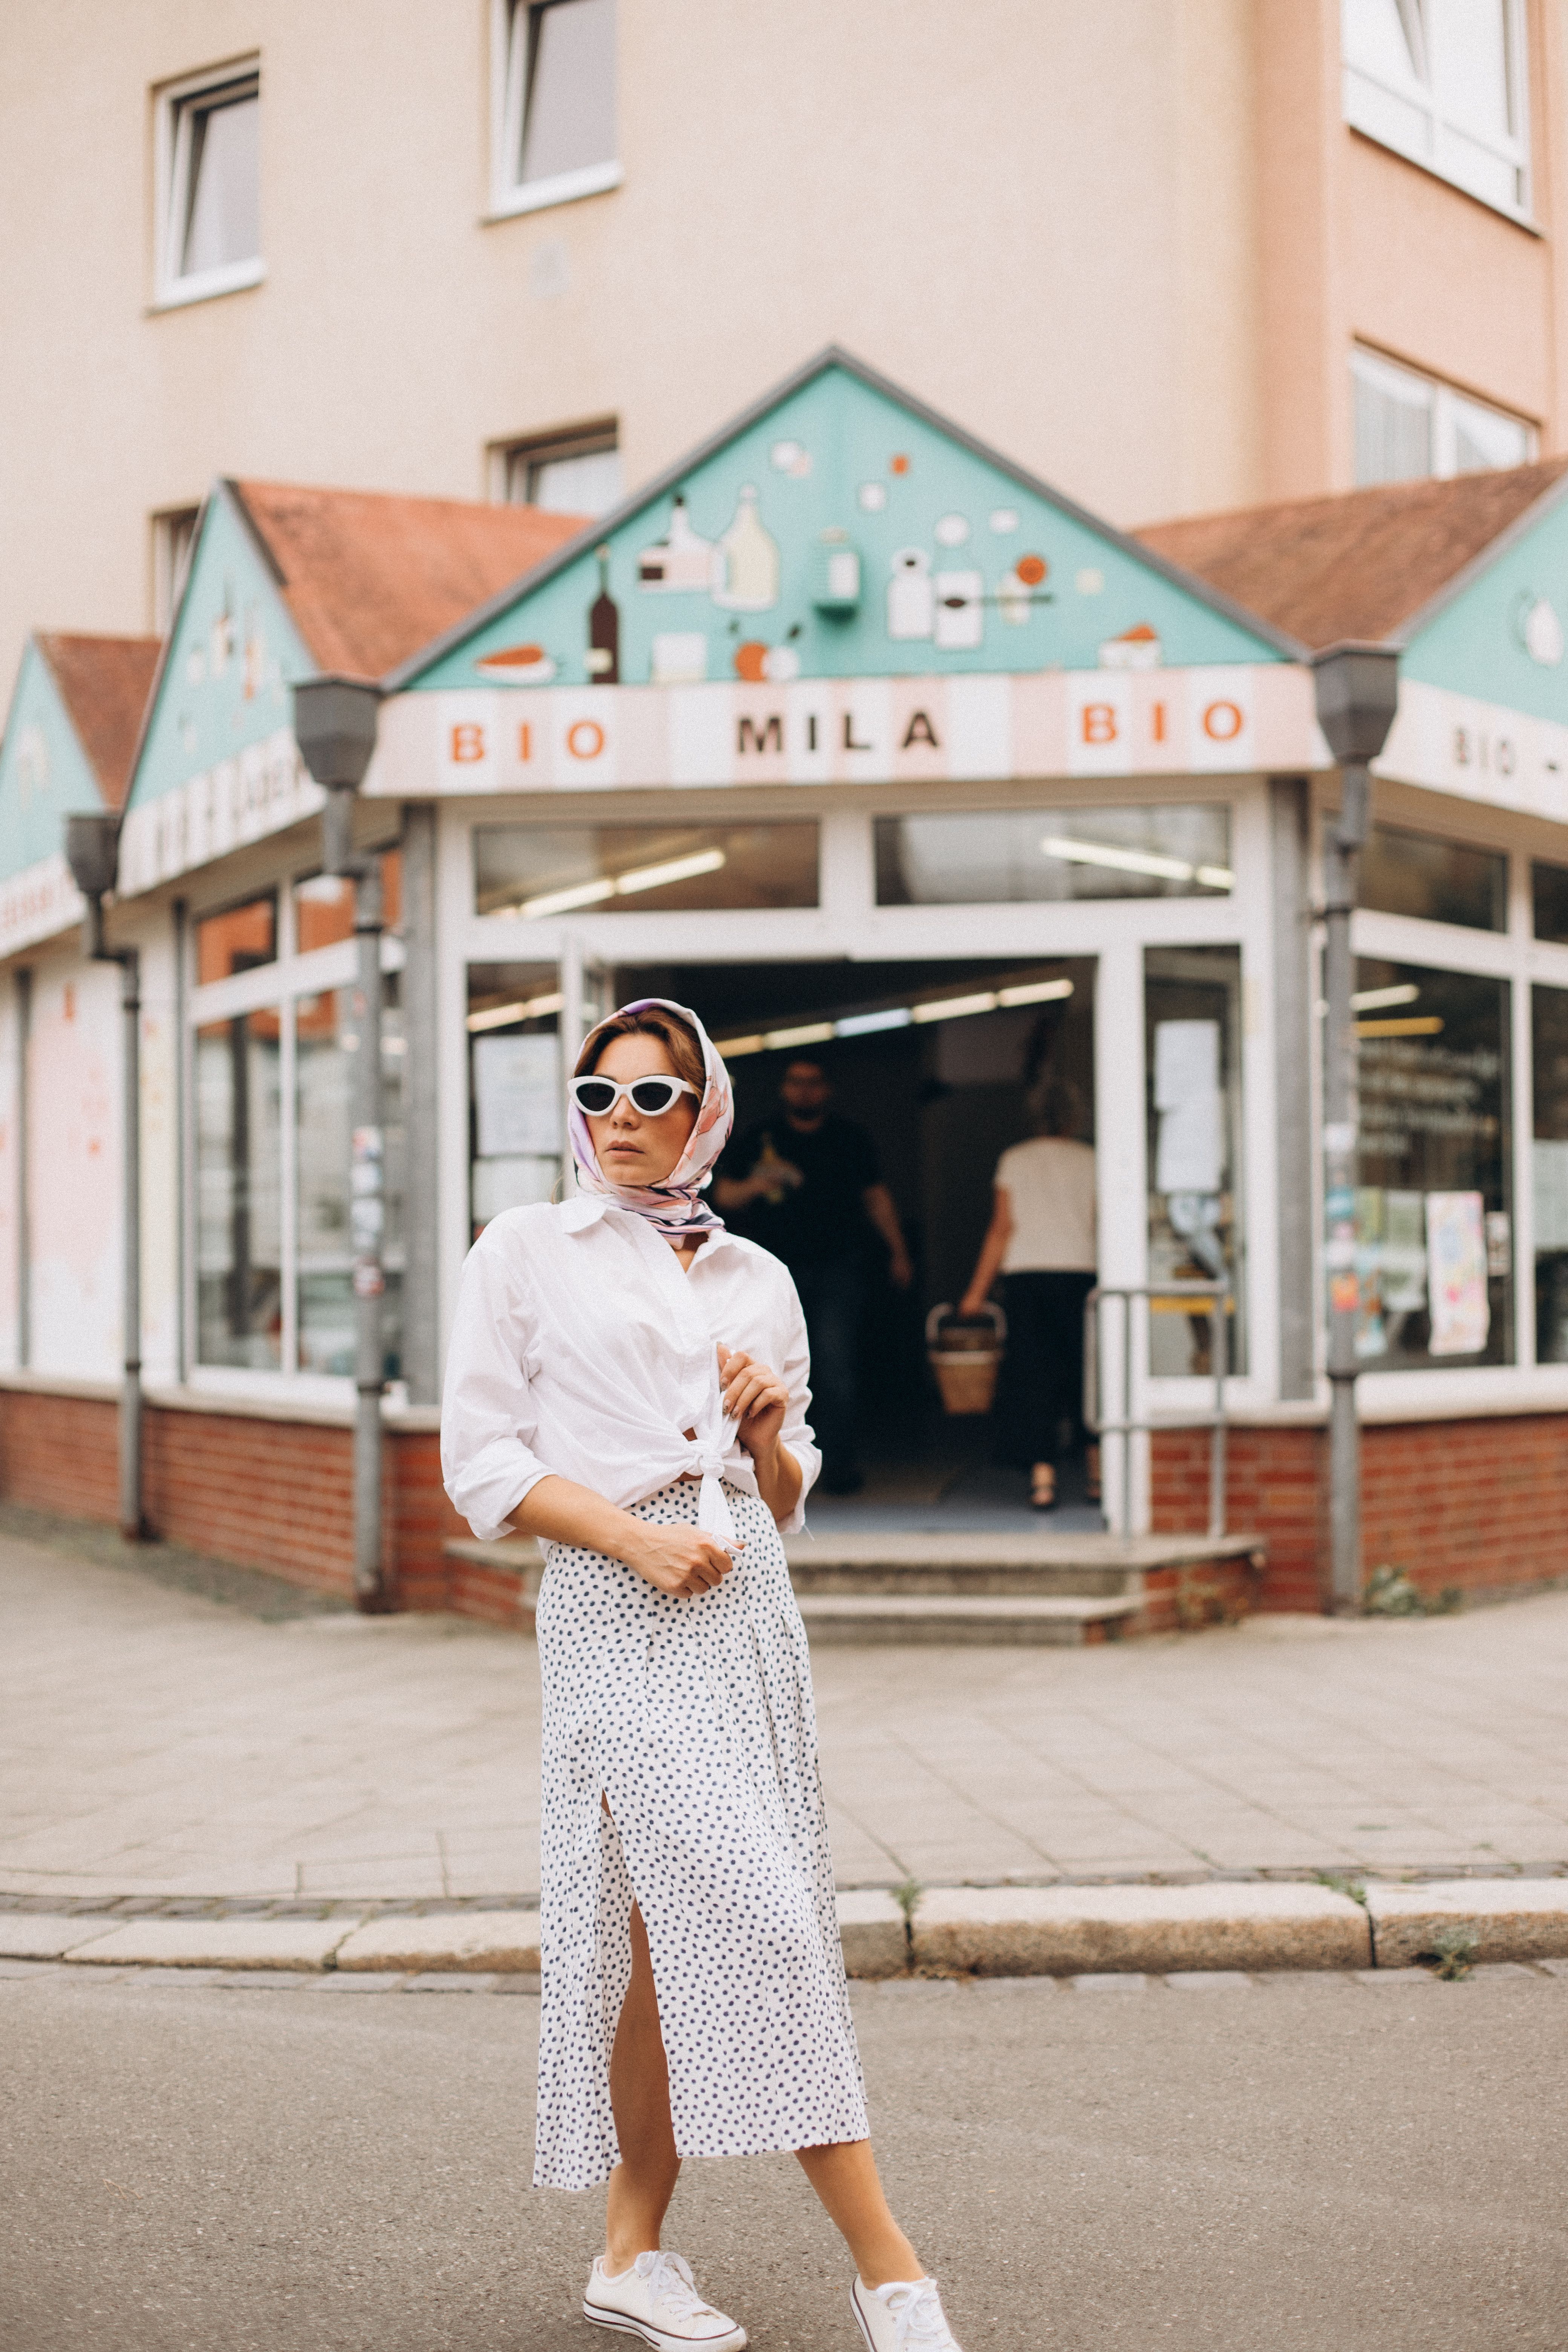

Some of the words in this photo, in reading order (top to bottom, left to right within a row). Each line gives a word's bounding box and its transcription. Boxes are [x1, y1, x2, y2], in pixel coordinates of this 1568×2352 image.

[450, 720, 607, 764] BIO
[736, 710, 940, 754] MILA
[1080, 700, 1245, 746] BIO
